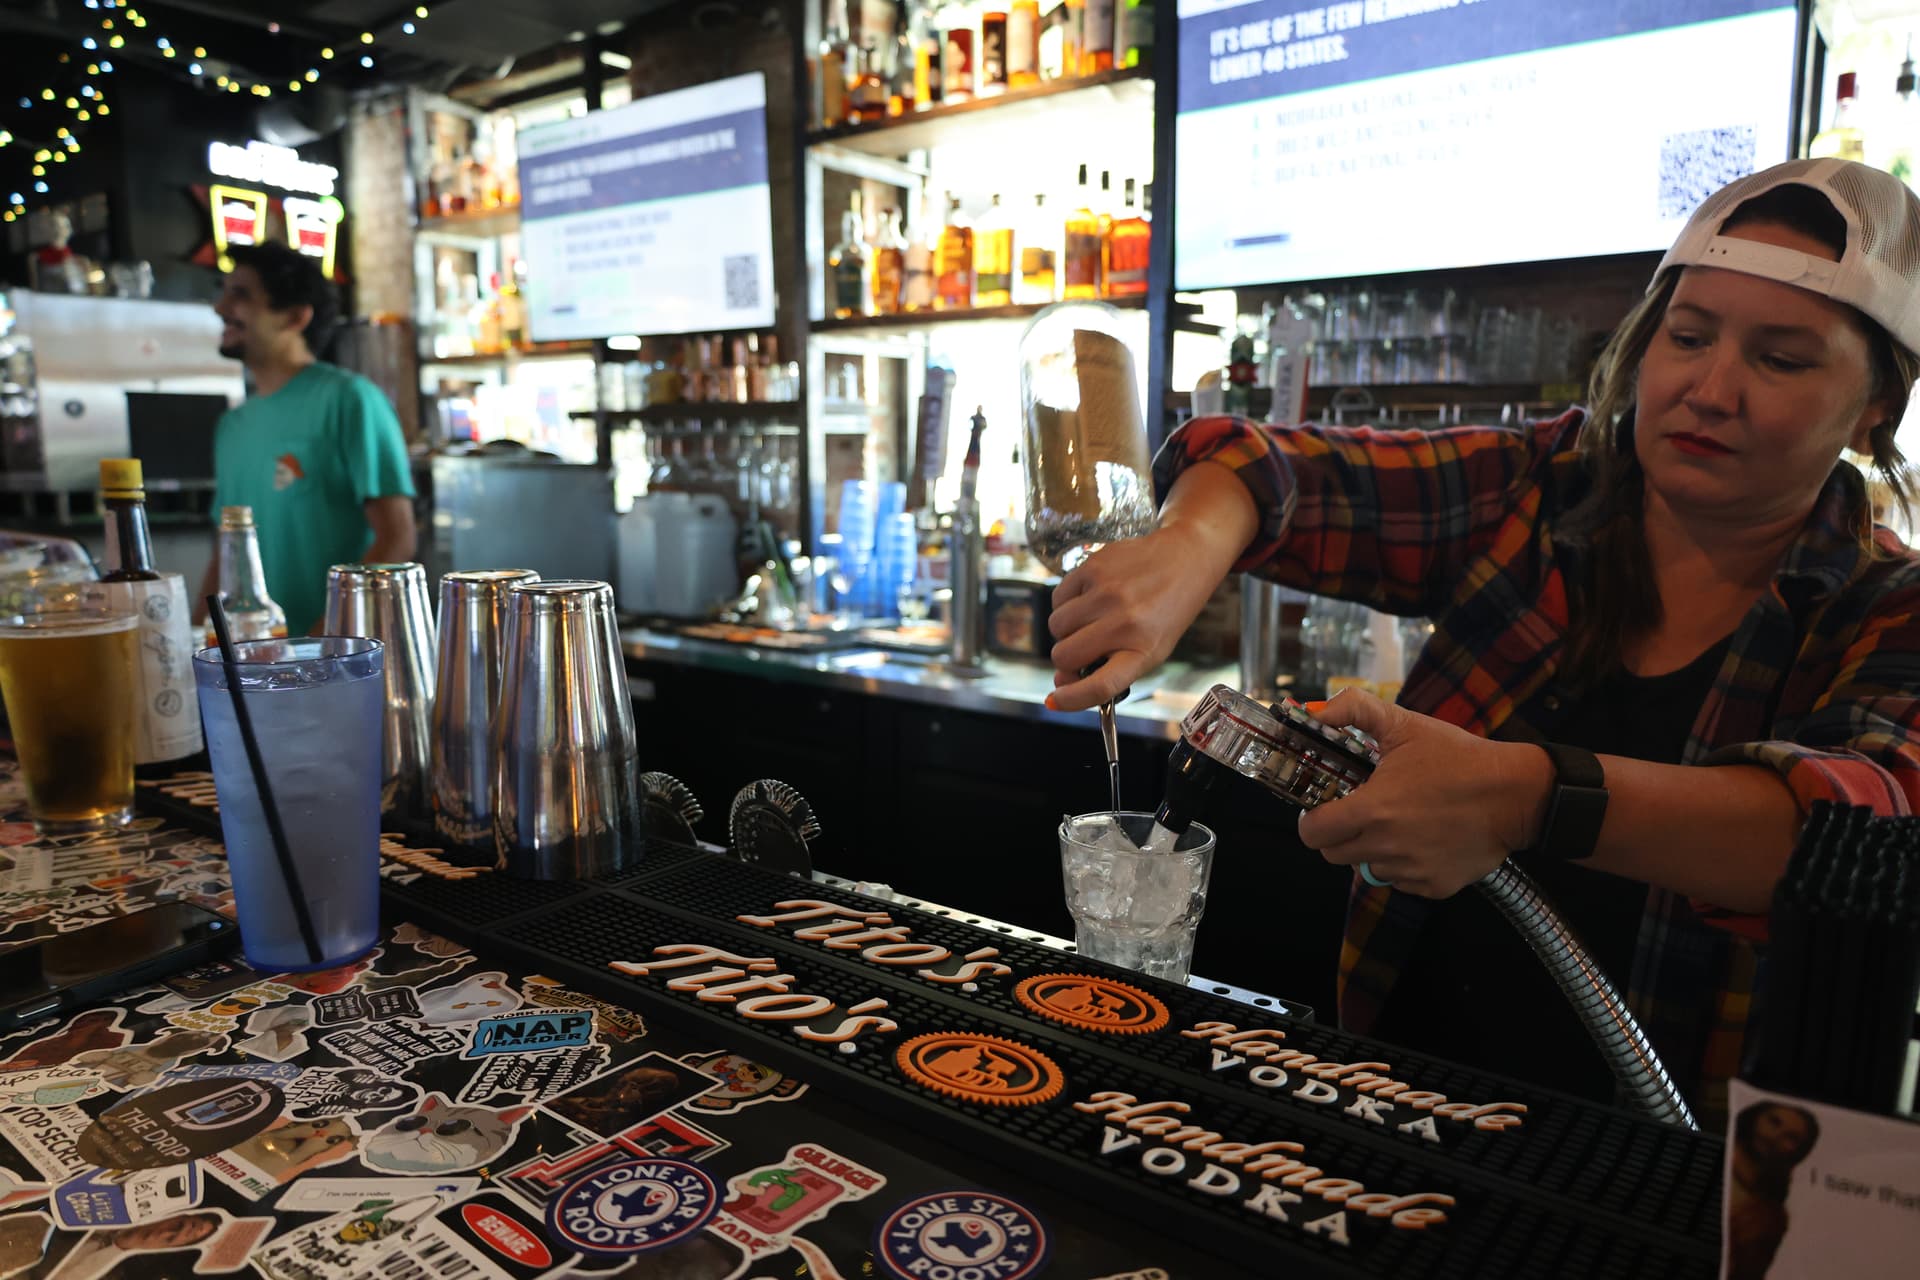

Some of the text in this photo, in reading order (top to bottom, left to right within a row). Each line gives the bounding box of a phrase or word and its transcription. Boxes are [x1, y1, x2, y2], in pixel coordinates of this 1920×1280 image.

[736, 899, 1011, 984] Tito's
[608, 943, 898, 1046] Tito's
[493, 1007, 578, 1020] WORK HARD
[494, 1016, 586, 1040] NAP
[384, 1045, 415, 1060] CARE
[492, 1032, 583, 1048] HARDER
[0, 1067, 87, 1087] ips tea
[185, 1064, 273, 1077] LEASE
[468, 1055, 515, 1101] titious.
[534, 1056, 557, 1070] but
[1180, 1020, 1527, 1131] Handmade
[283, 1069, 333, 1104] POSITI
[521, 1077, 539, 1090] am
[1210, 1048, 1440, 1143] VODKA
[13, 1107, 52, 1128] TOP
[54, 1107, 82, 1122] MY
[118, 1106, 158, 1134] THE
[142, 1128, 191, 1158] DRIP
[33, 1127, 89, 1171] SECRET
[204, 1152, 246, 1180] amma
[1072, 1090, 1456, 1229] Handmade
[794, 1147, 881, 1190] GRINCH
[591, 1165, 706, 1219] LONE STAR
[1101, 1126, 1350, 1247] VODKA
[1825, 1174, 1871, 1199] saw
[475, 1214, 536, 1257] BEWARE
[565, 1206, 651, 1244] ROOTS
[891, 1198, 1033, 1239] LONE STAR
[430, 1251, 480, 1280] NOT
[907, 1254, 1021, 1280] ROOTS
